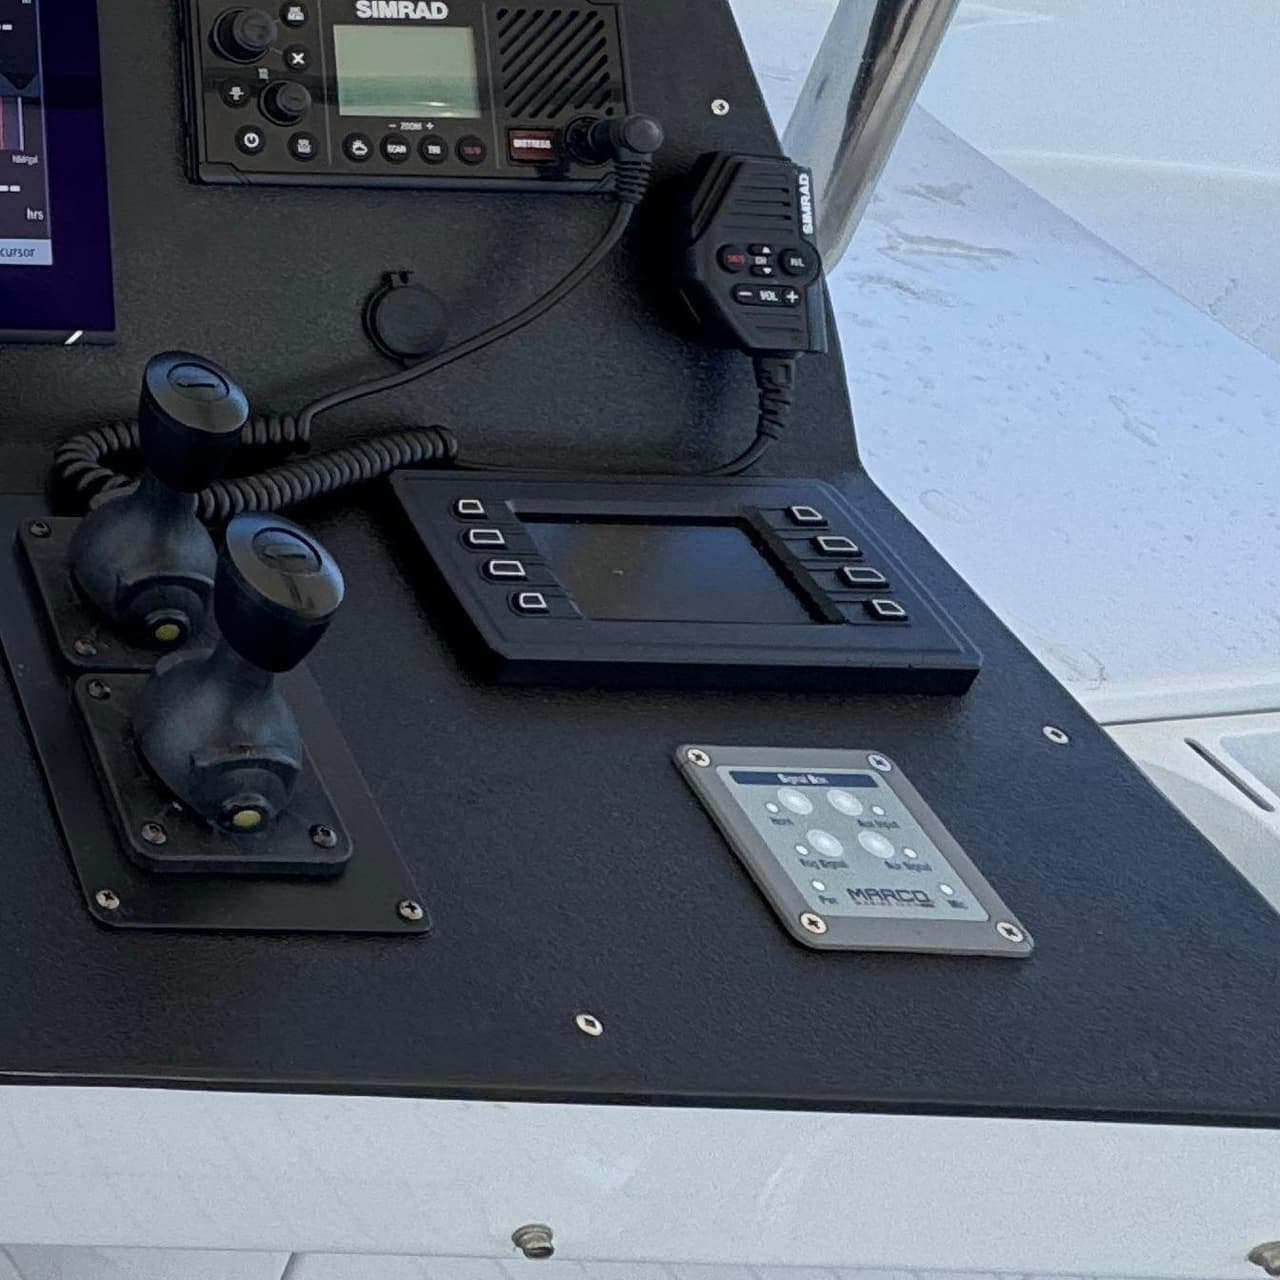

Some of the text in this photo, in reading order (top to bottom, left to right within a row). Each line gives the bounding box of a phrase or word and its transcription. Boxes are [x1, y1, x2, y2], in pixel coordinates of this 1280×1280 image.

[355, 0, 449, 20] SIMRAD
[799, 173, 814, 235] SIMRAD
[26, 207, 44, 220] hrs
[0, 246, 36, 258] cursor
[760, 290, 778, 301] VOL
[847, 888, 931, 903] MARCO
